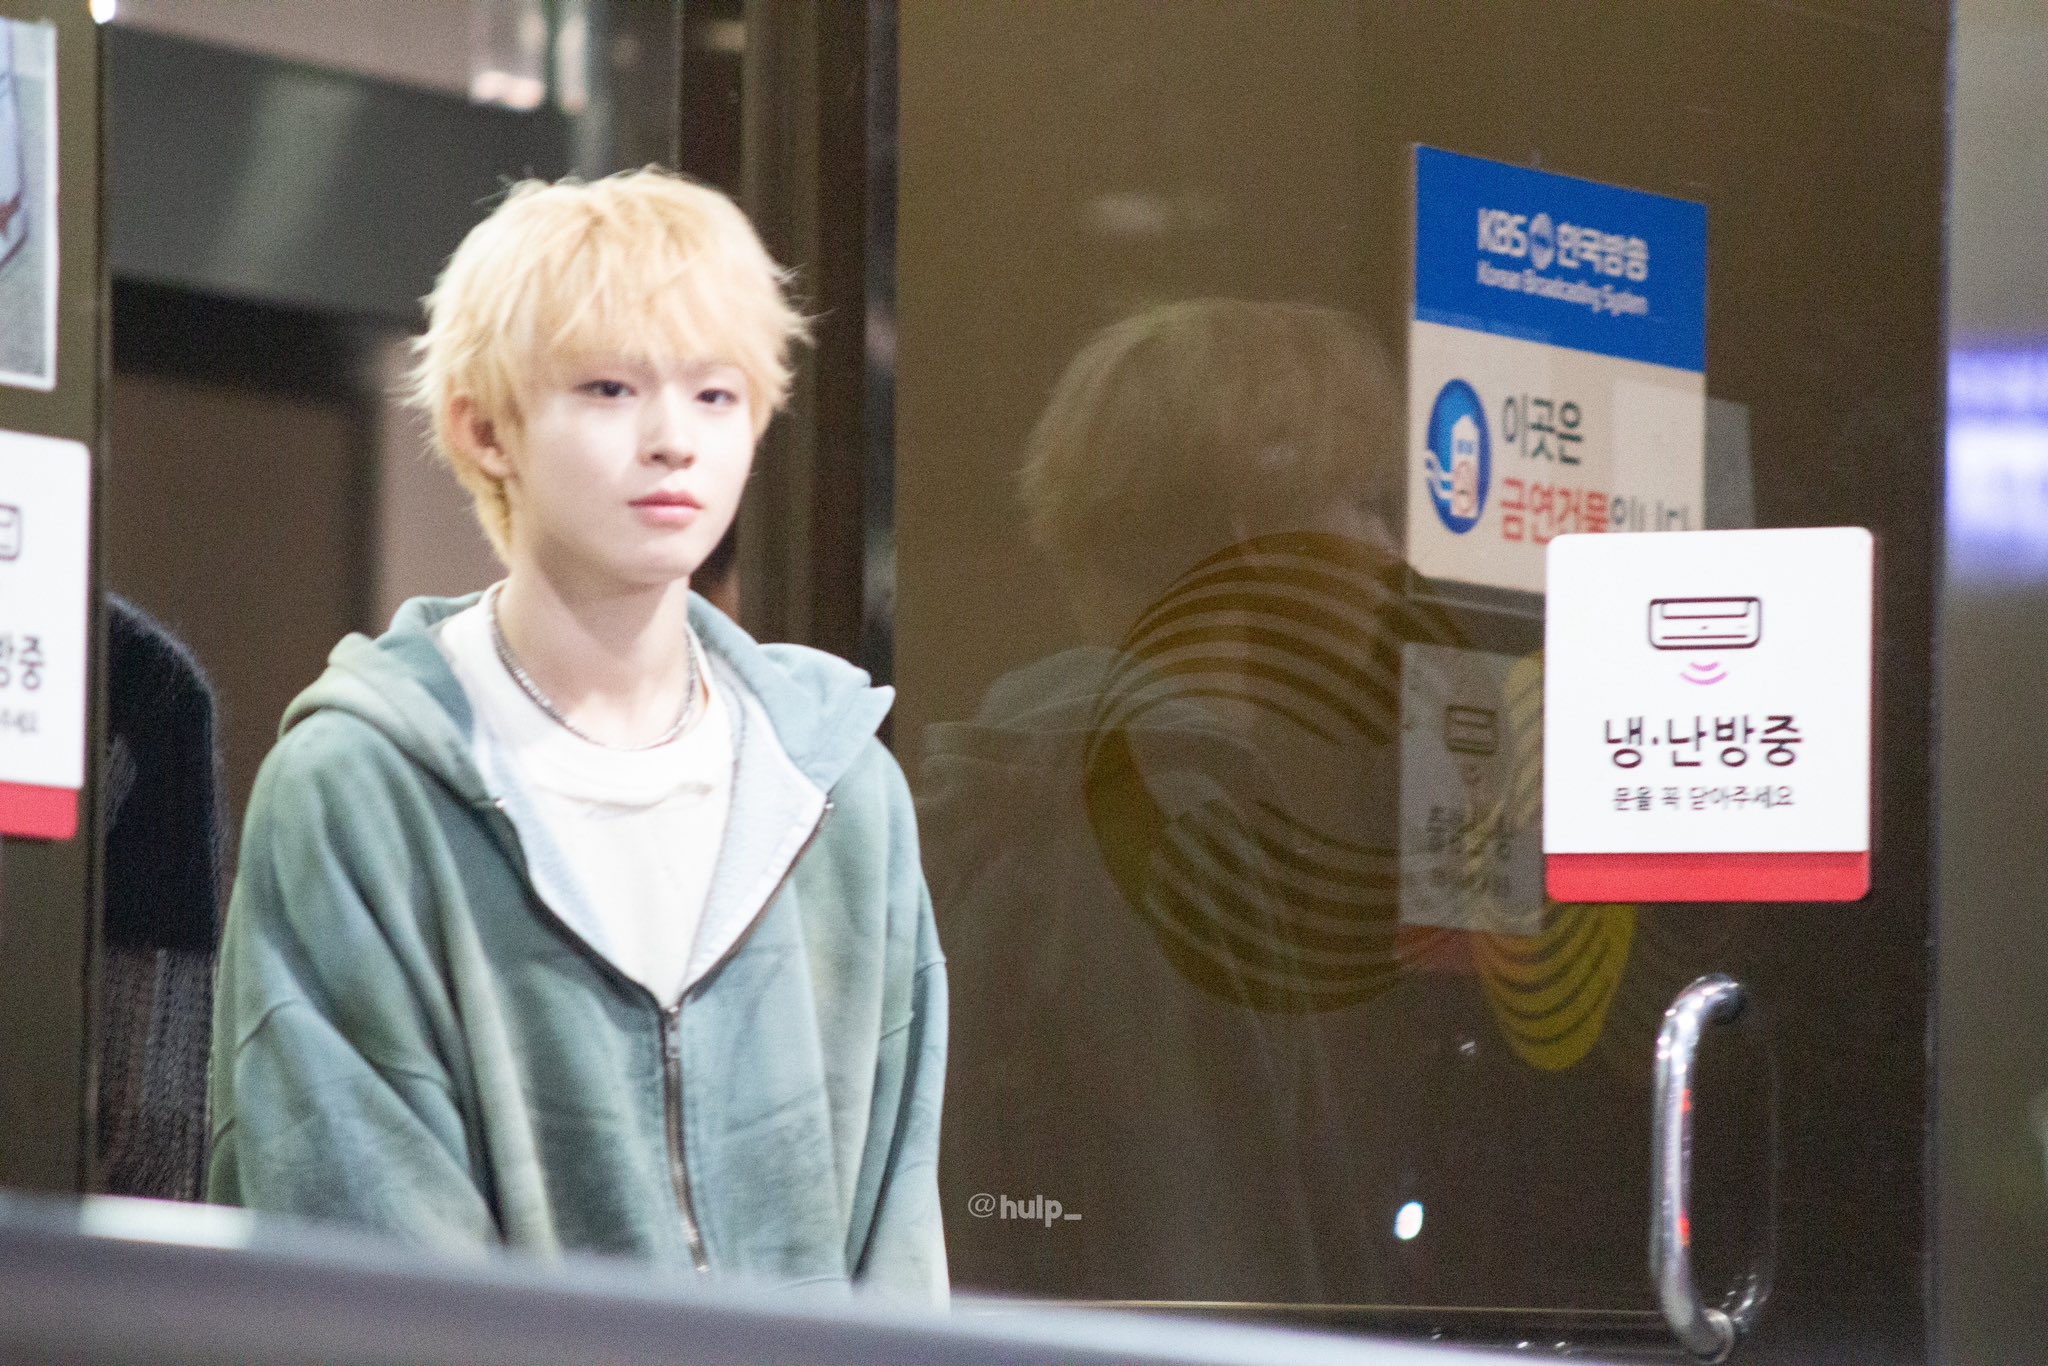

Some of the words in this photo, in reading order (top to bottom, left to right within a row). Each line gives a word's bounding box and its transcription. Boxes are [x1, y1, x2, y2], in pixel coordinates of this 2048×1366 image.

[1478, 208, 1528, 258] KBS
[1557, 222, 1648, 282] 한국방송
[1503, 393, 1583, 466] 이곳은
[1605, 714, 1802, 769] 냉·난방중
[1614, 785, 1651, 811] 문을
[1661, 785, 1680, 812] 꼭
[1690, 784, 1794, 811] 닫아주세요
